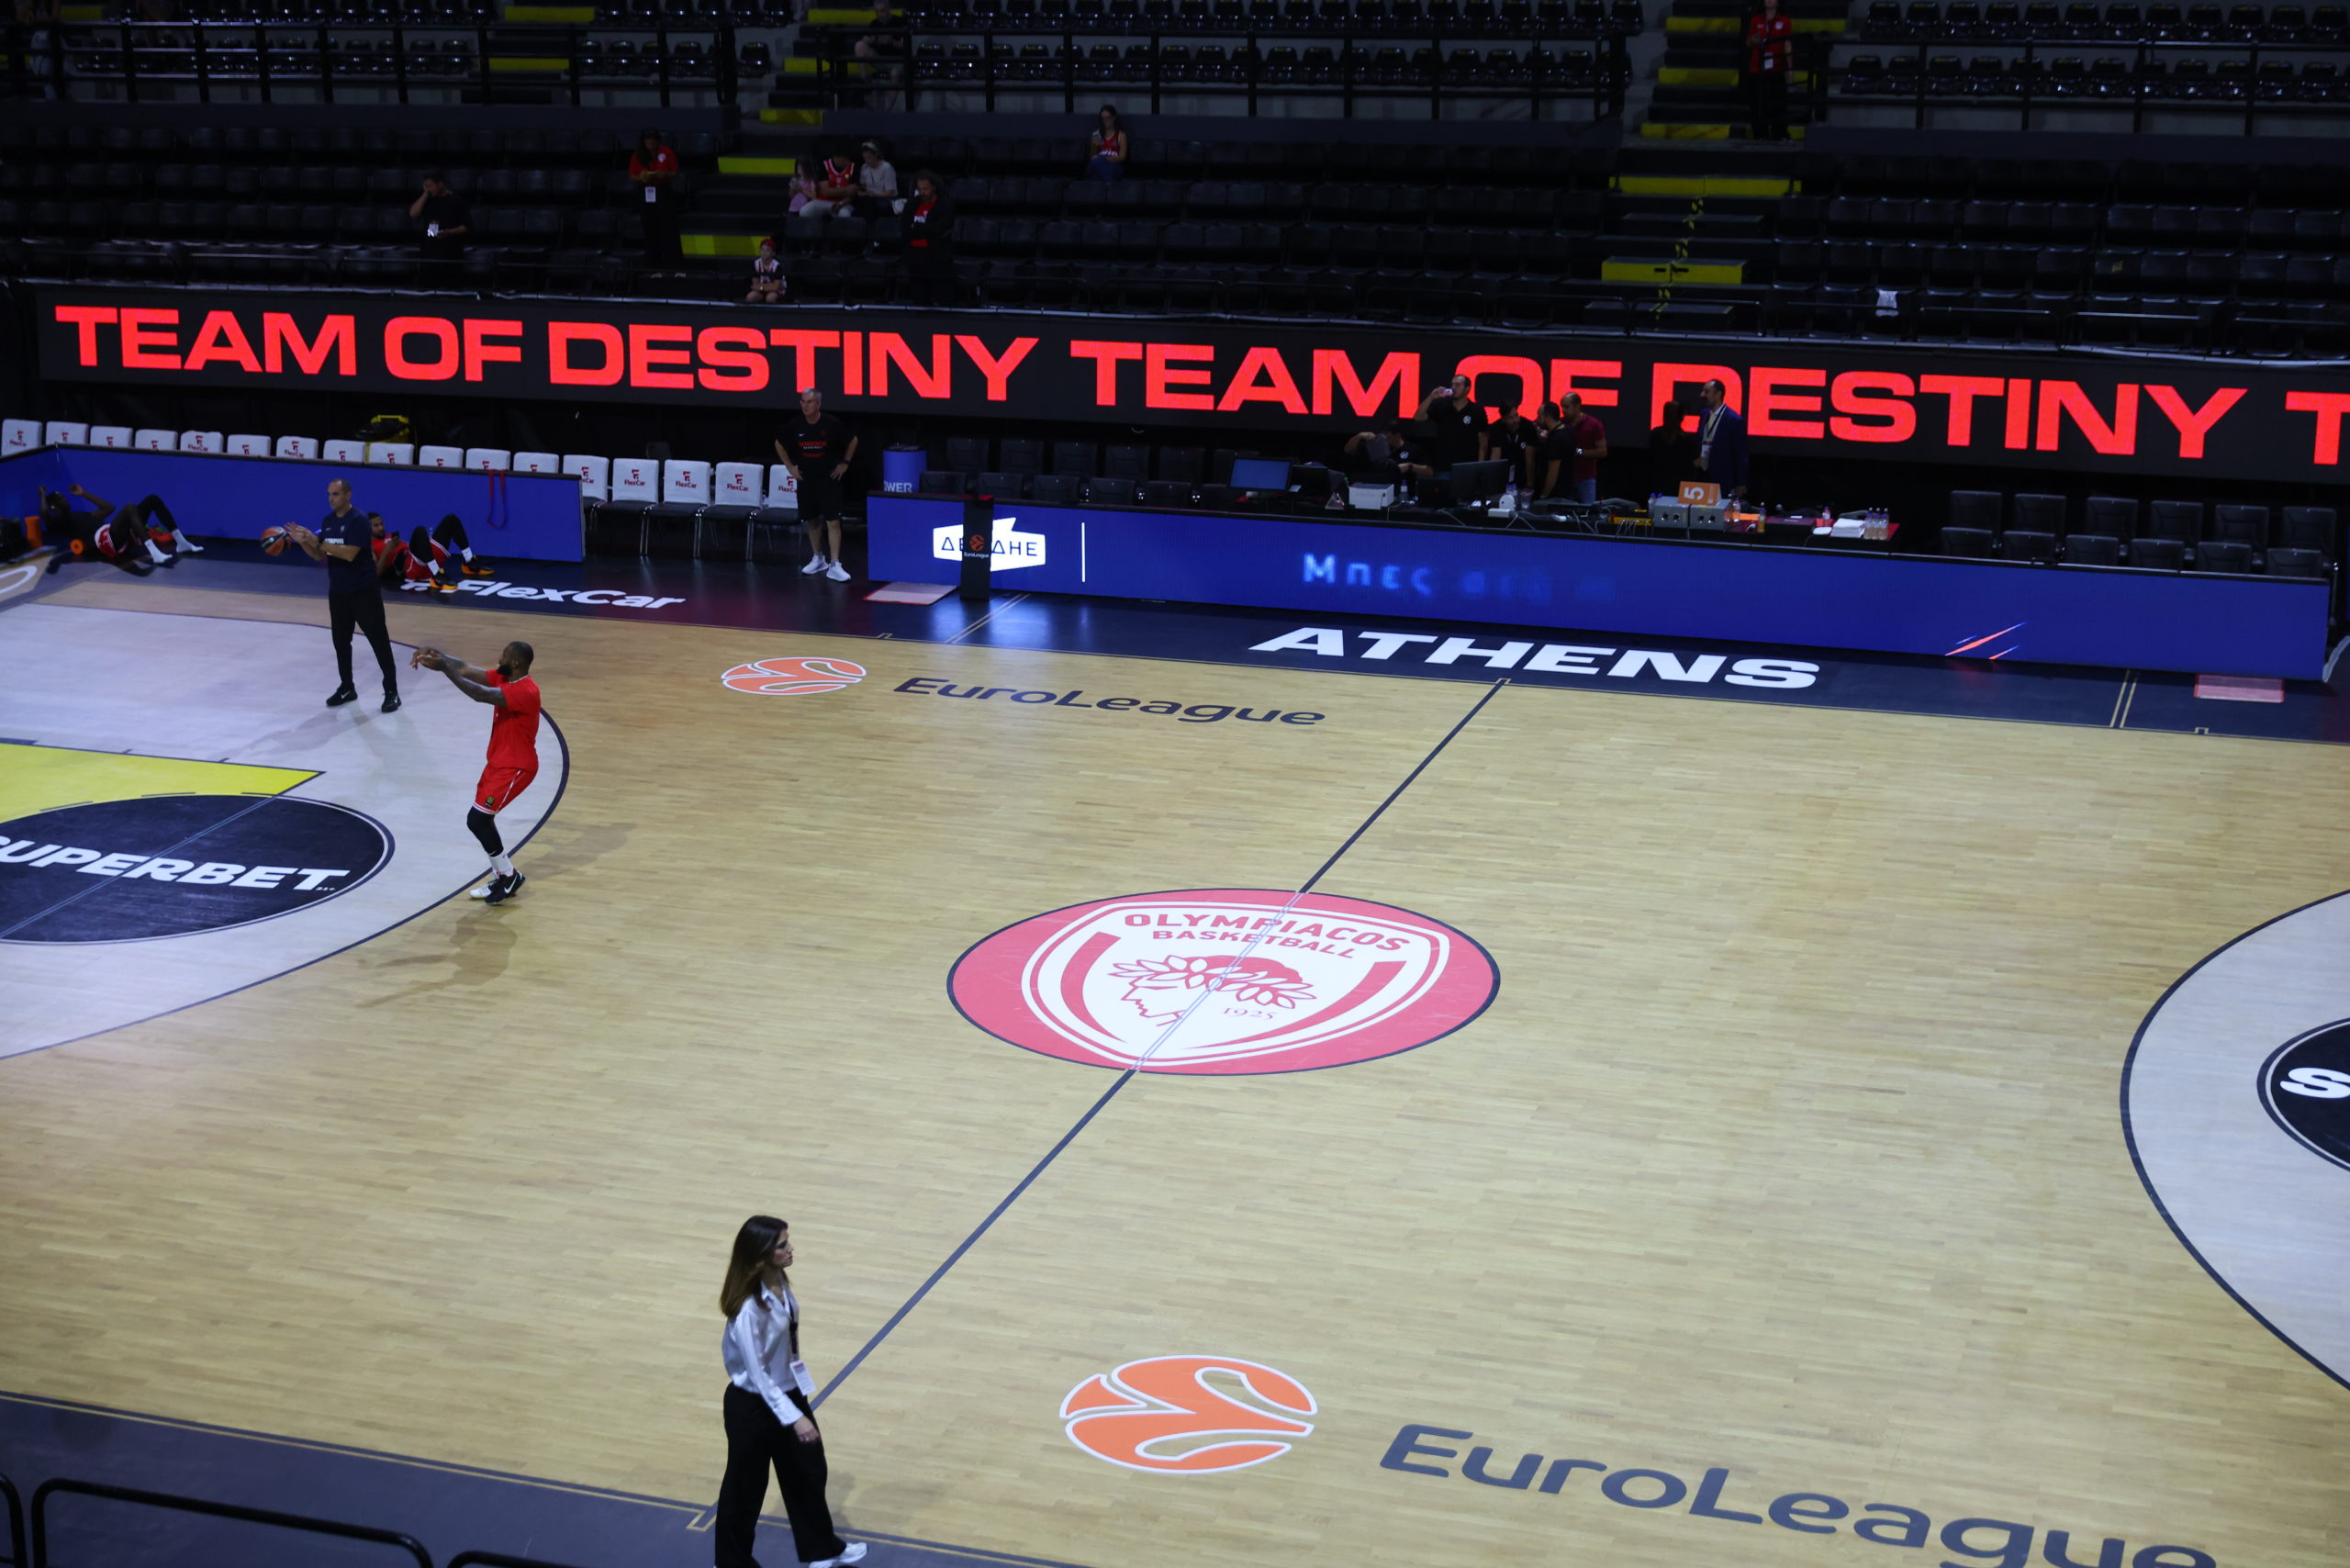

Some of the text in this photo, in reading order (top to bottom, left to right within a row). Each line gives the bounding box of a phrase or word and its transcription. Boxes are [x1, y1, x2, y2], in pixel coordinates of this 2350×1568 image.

[56, 306, 356, 375] TEAM
[384, 317, 523, 382] OF
[548, 322, 1039, 401] DESTINY
[1070, 340, 1420, 419] TEAM
[1455, 354, 1622, 424] OF
[1651, 363, 2248, 459] DESTINY
[439, 579, 687, 609] FlexCar
[1248, 627, 1820, 689] ATHENS
[893, 677, 1326, 726] EuroLeague
[1124, 913, 1411, 951] OLYMPIACOS
[1151, 930, 1358, 959] BASKETBALL
[1221, 1007, 1280, 1021] 1925
[1380, 1424, 2218, 1568] EuroLeague
